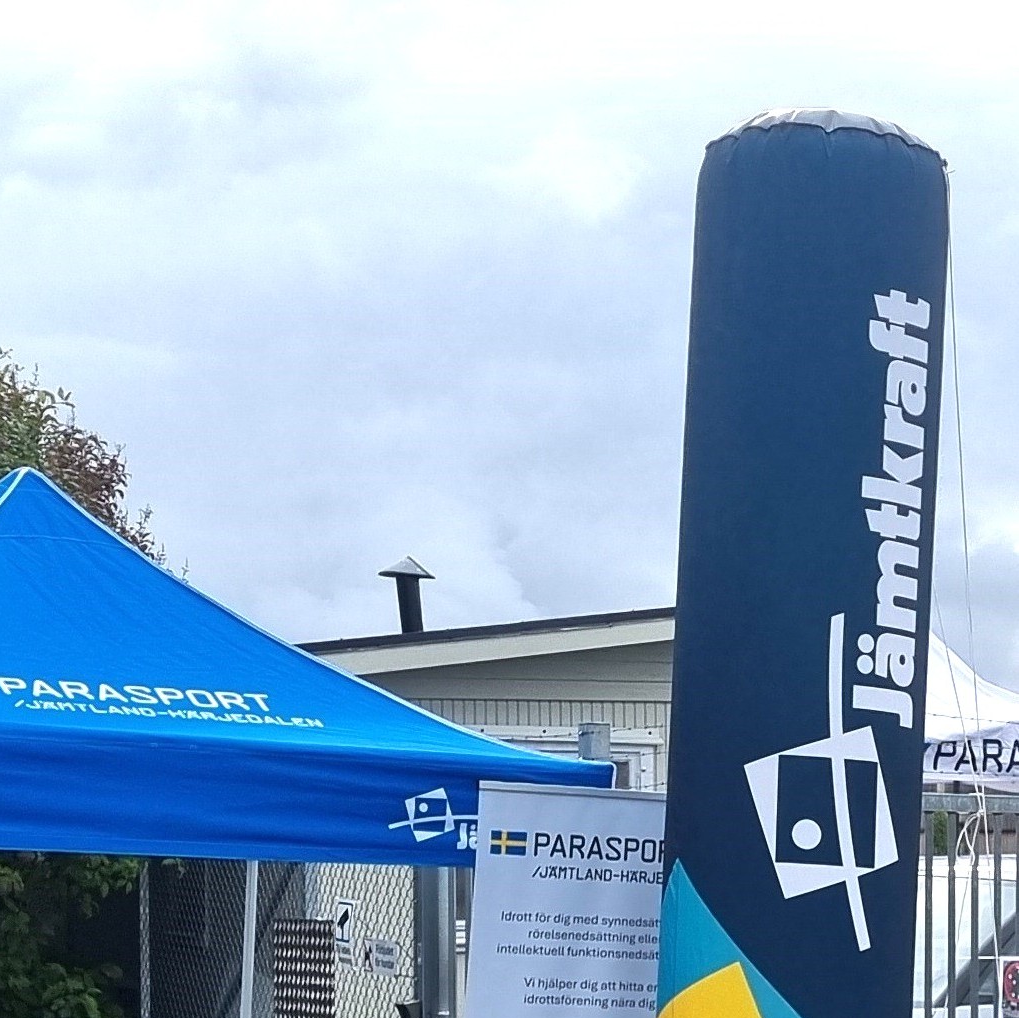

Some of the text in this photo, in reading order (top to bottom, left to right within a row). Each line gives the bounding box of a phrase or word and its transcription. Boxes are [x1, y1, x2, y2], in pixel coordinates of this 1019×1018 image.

[852, 289, 931, 729] Jämtkraft
[501, 911, 661, 929] Idrott för dig med synnedsät
[528, 929, 636, 945] rörelsenedsättning
[496, 943, 565, 957] intellektuell
[523, 977, 535, 988] Vi
[537, 977, 578, 991] hjälper
[580, 979, 598, 992] dig
[600, 980, 616, 991] att
[619, 980, 643, 992] hitta
[523, 994, 609, 1009] idrottsförening
[611, 998, 636, 1008] nära
